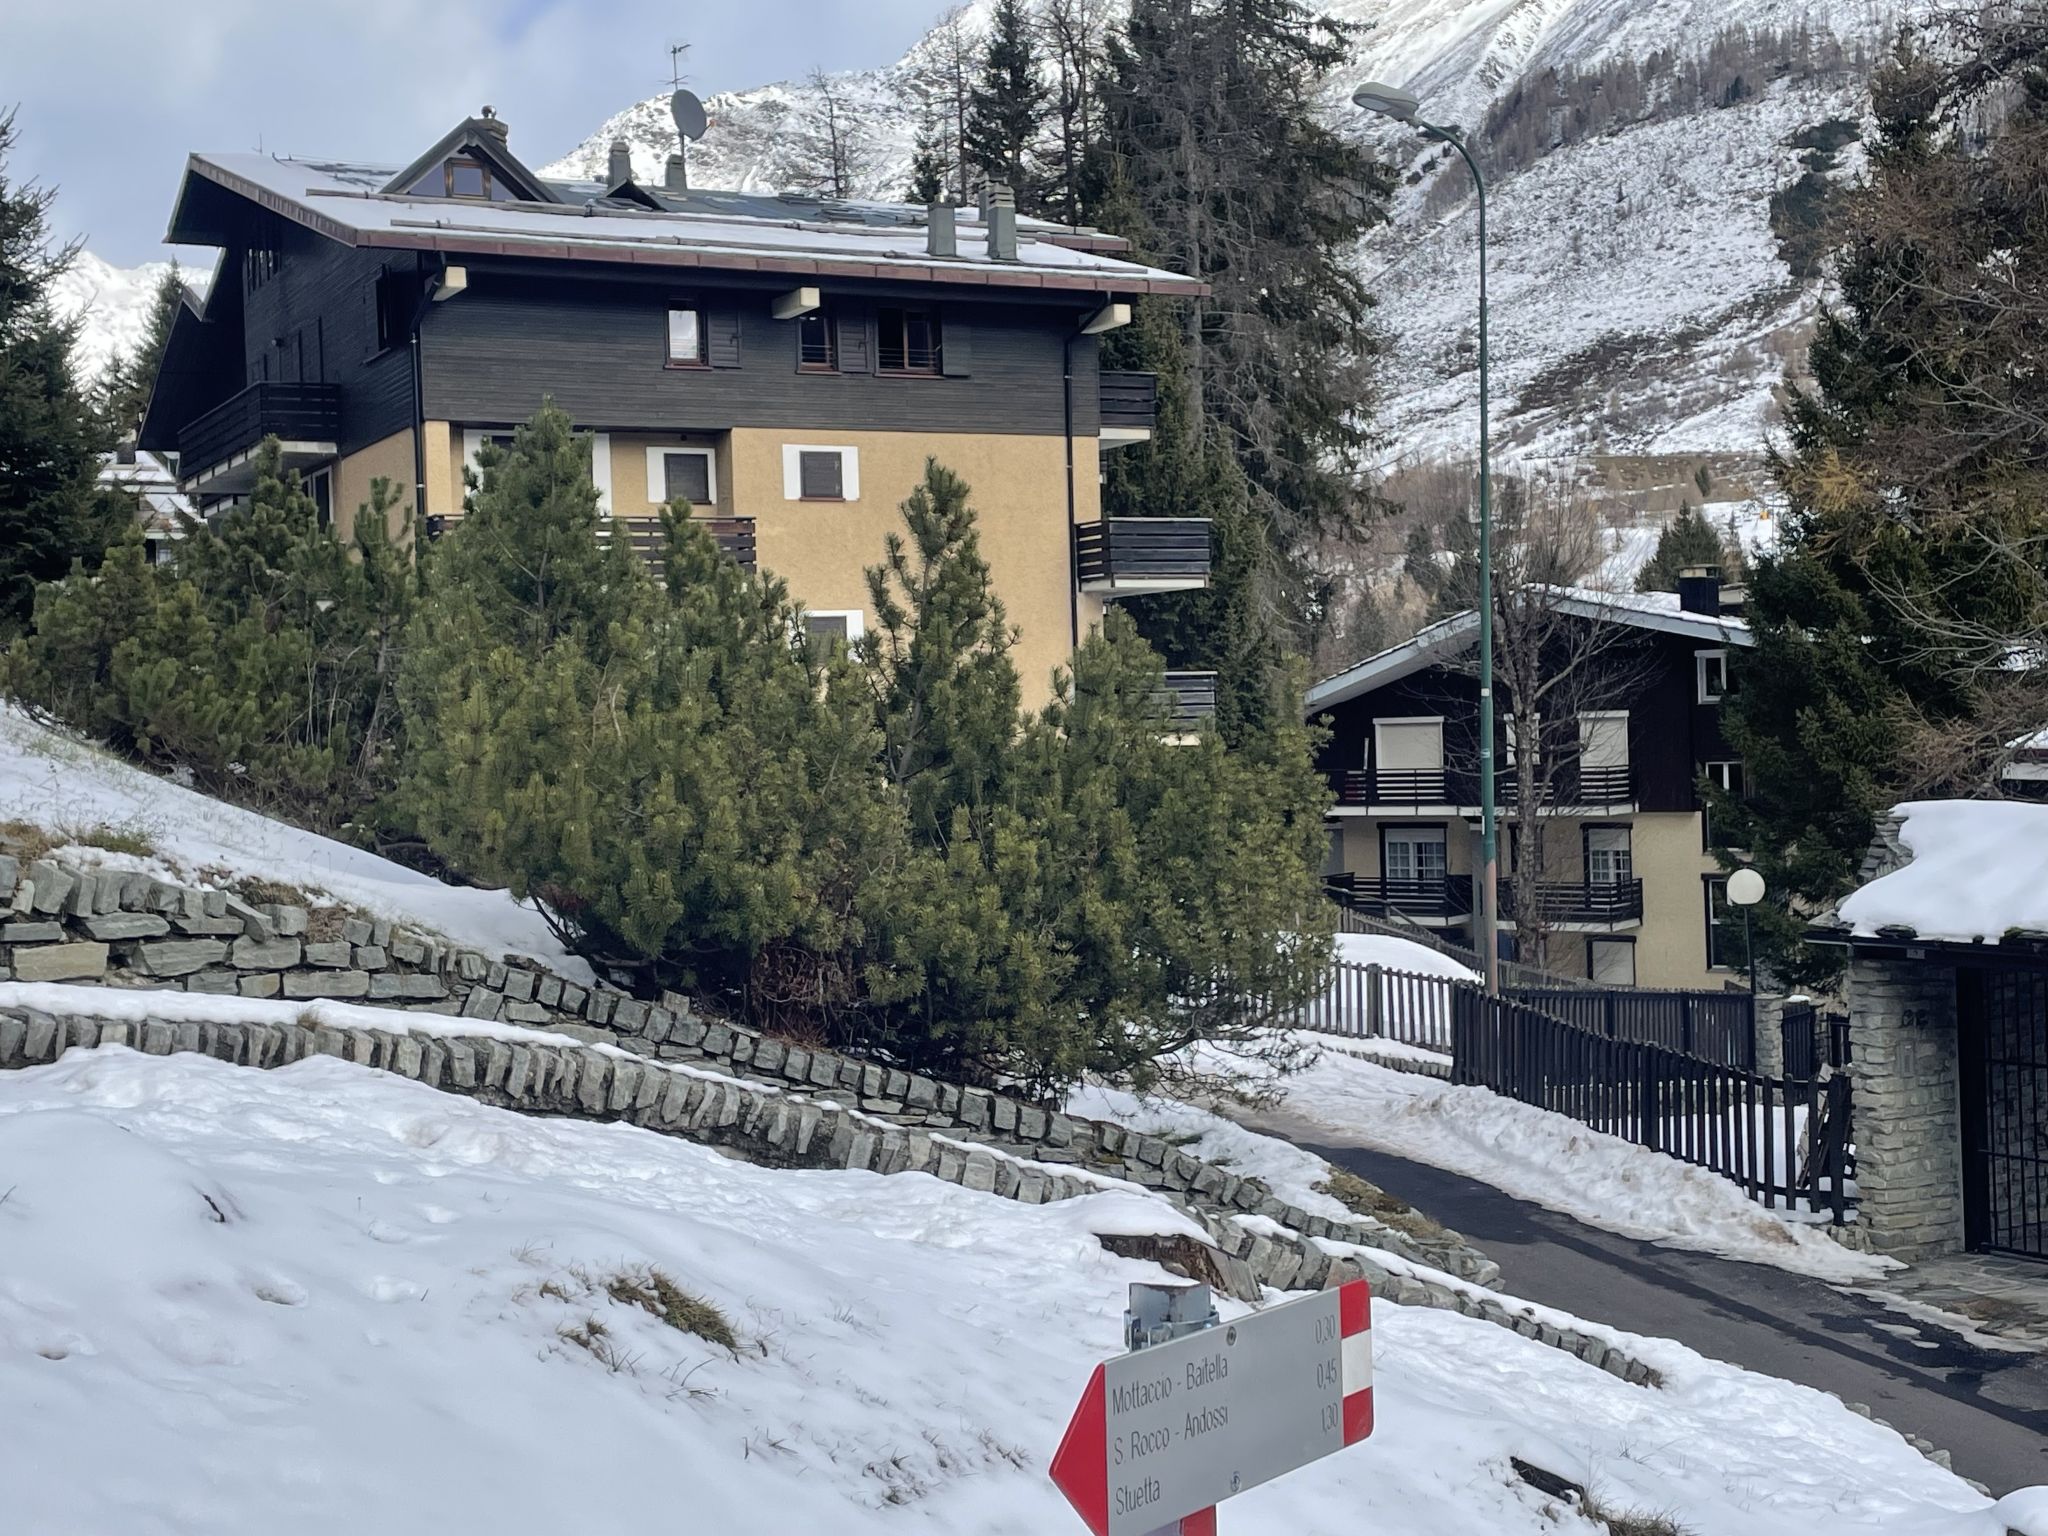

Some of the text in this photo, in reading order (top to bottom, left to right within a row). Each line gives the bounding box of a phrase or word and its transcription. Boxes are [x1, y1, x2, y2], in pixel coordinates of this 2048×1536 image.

[1315, 1314, 1336, 1344] 0,30
[1112, 1373, 1172, 1416] Mottaccio
[1186, 1353, 1228, 1390] Baitella
[1316, 1358, 1337, 1390] 0,45
[1131, 1427, 1170, 1460] Rocco
[1184, 1405, 1229, 1441] Andossi
[1115, 1475, 1161, 1516] Stuetta
